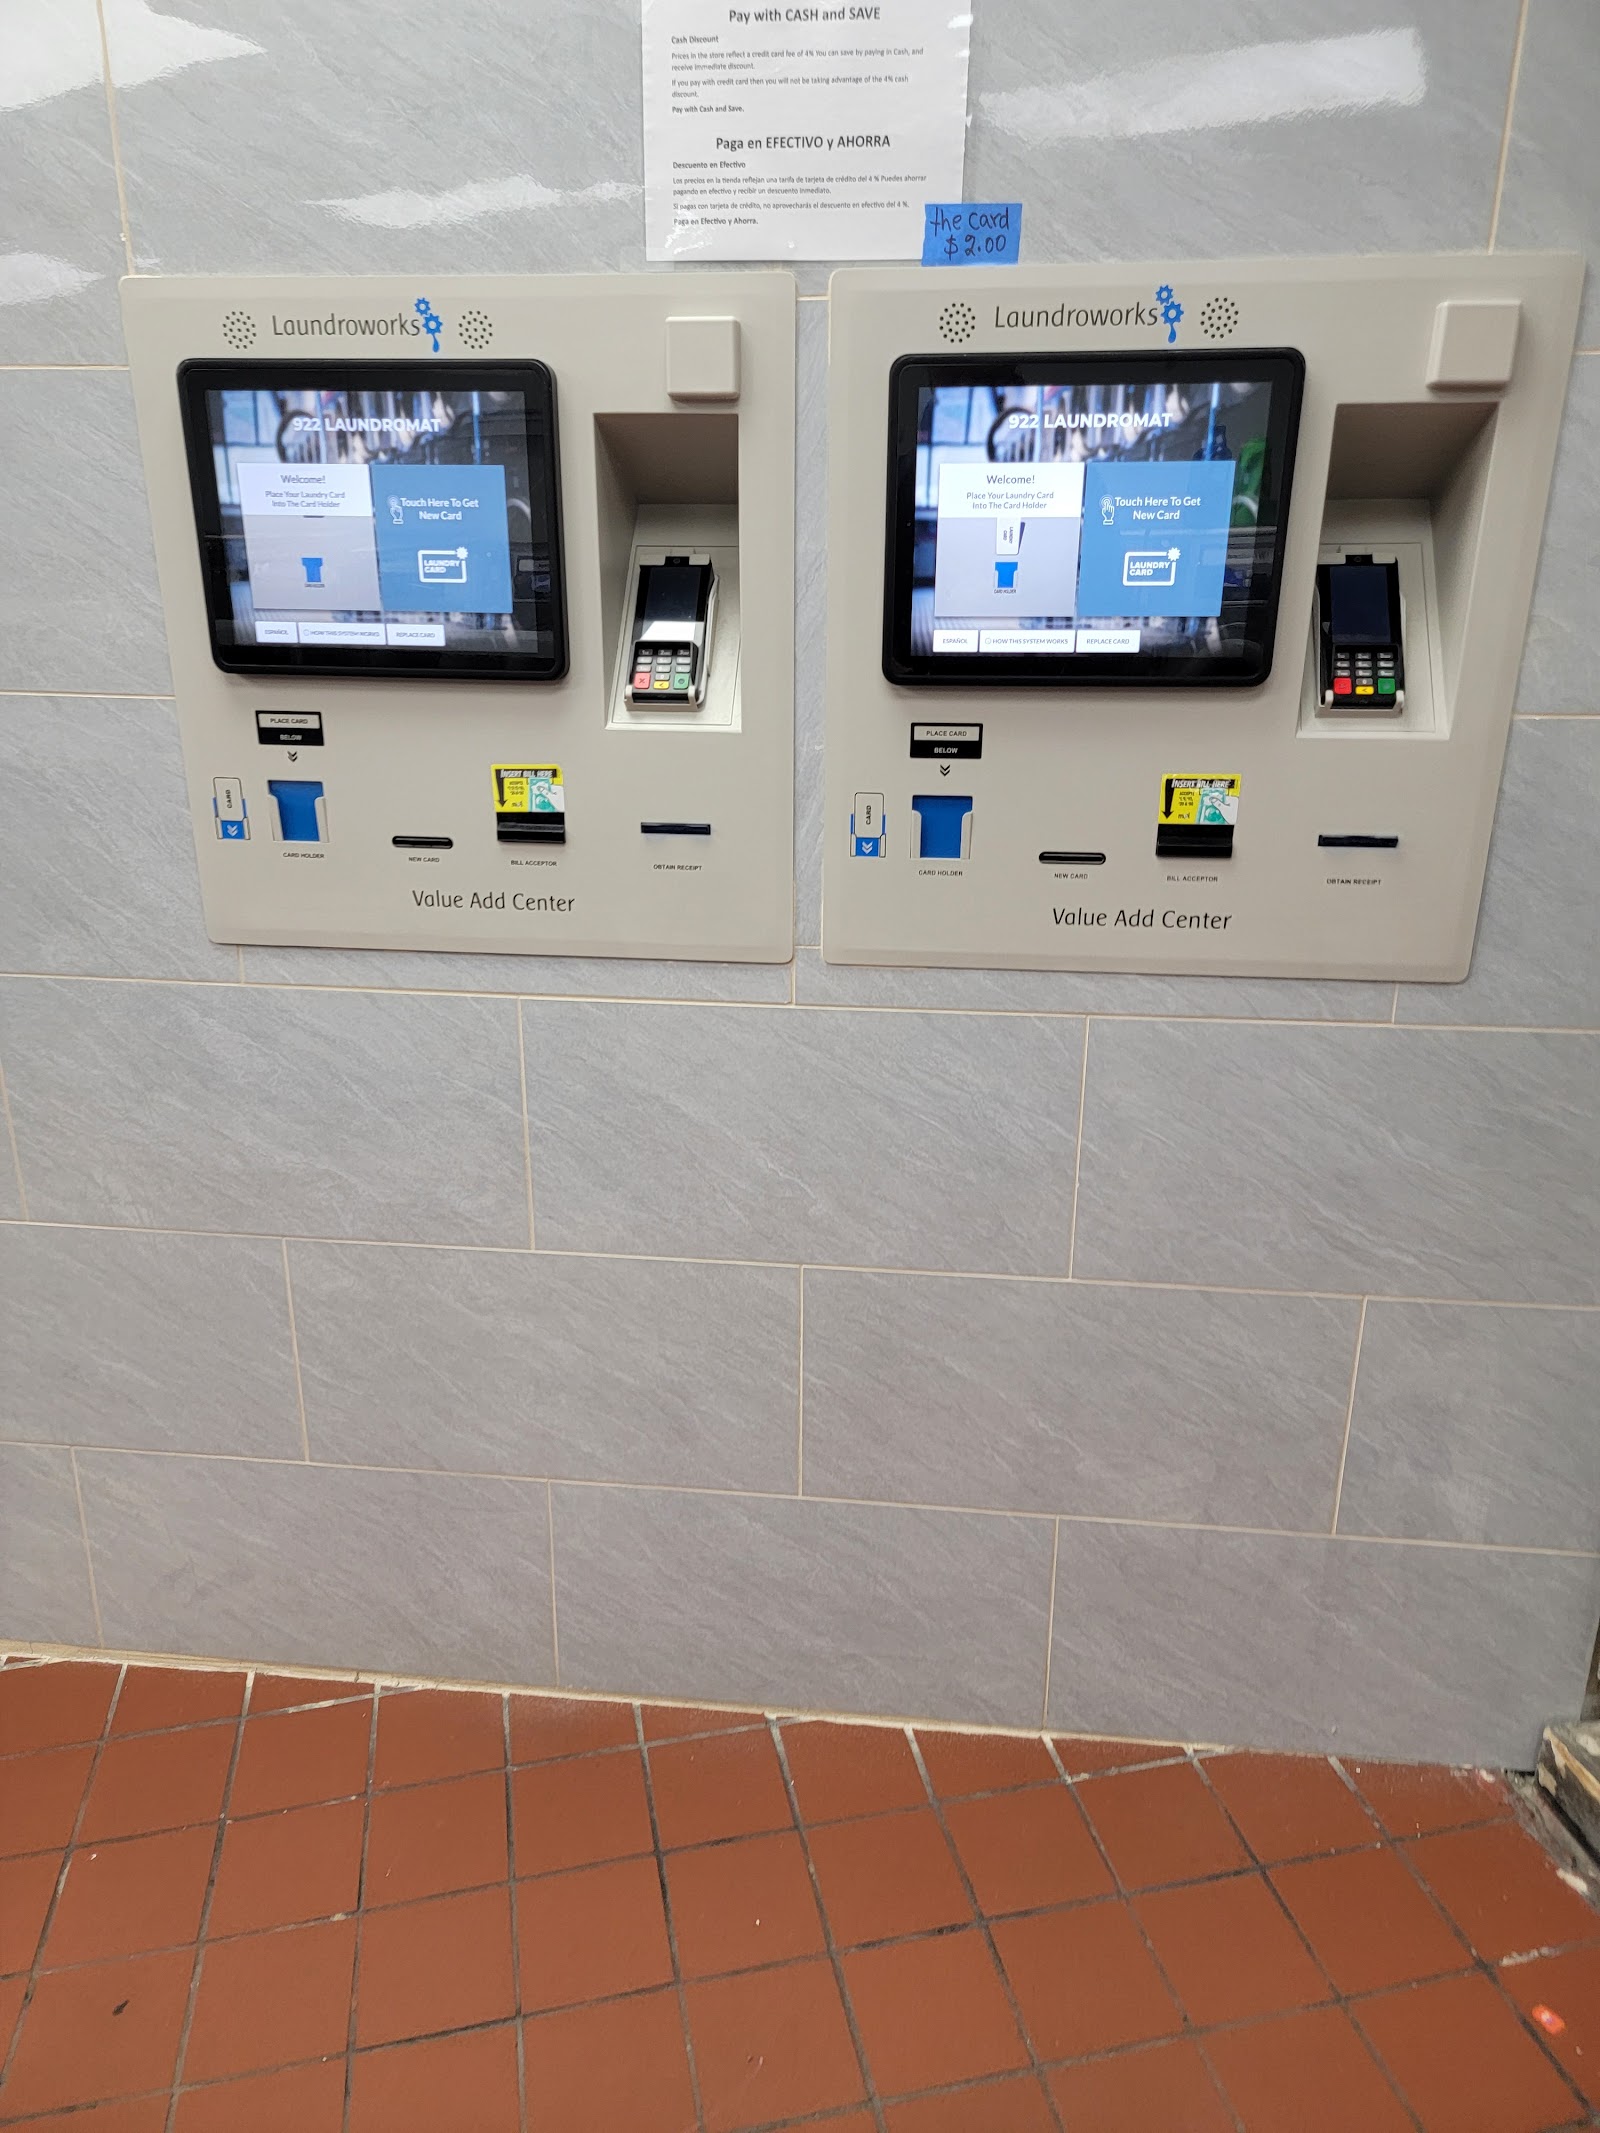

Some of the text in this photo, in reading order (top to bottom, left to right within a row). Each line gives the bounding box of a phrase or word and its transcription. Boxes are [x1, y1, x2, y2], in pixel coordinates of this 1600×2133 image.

[729, 7, 881, 24] Pay with CASH and SAVE
[671, 35, 718, 44] Cash Discount
[865, 48, 884, 56] paying
[894, 48, 910, 56] Cash,
[912, 47, 923, 55] and
[811, 77, 829, 85] taking
[831, 76, 862, 84] advantage
[716, 135, 891, 151] Paga en EFECTIVO y AHORRA
[930, 207, 1009, 237] the card
[995, 302, 1158, 328] Laundroworks
[272, 313, 420, 337] Laundroworks
[293, 418, 441, 432] 922 LAUNDROMAT
[1009, 412, 1172, 429] 922 LAUNDROMAT
[281, 475, 326, 484] Welcome!
[987, 474, 1035, 484] Welcome!
[301, 491, 327, 501] Laundry
[1006, 492, 1034, 501] Laundry
[401, 498, 479, 508] Touch Here To Get
[1115, 497, 1200, 506] Touch Here To Get
[419, 511, 462, 520] New Card
[1133, 510, 1180, 520] New Card
[1130, 561, 1170, 569] LAUNDRY
[1129, 568, 1153, 576] CARD
[413, 890, 575, 912] Value Add Center
[1053, 908, 1232, 929] Value Add Center
